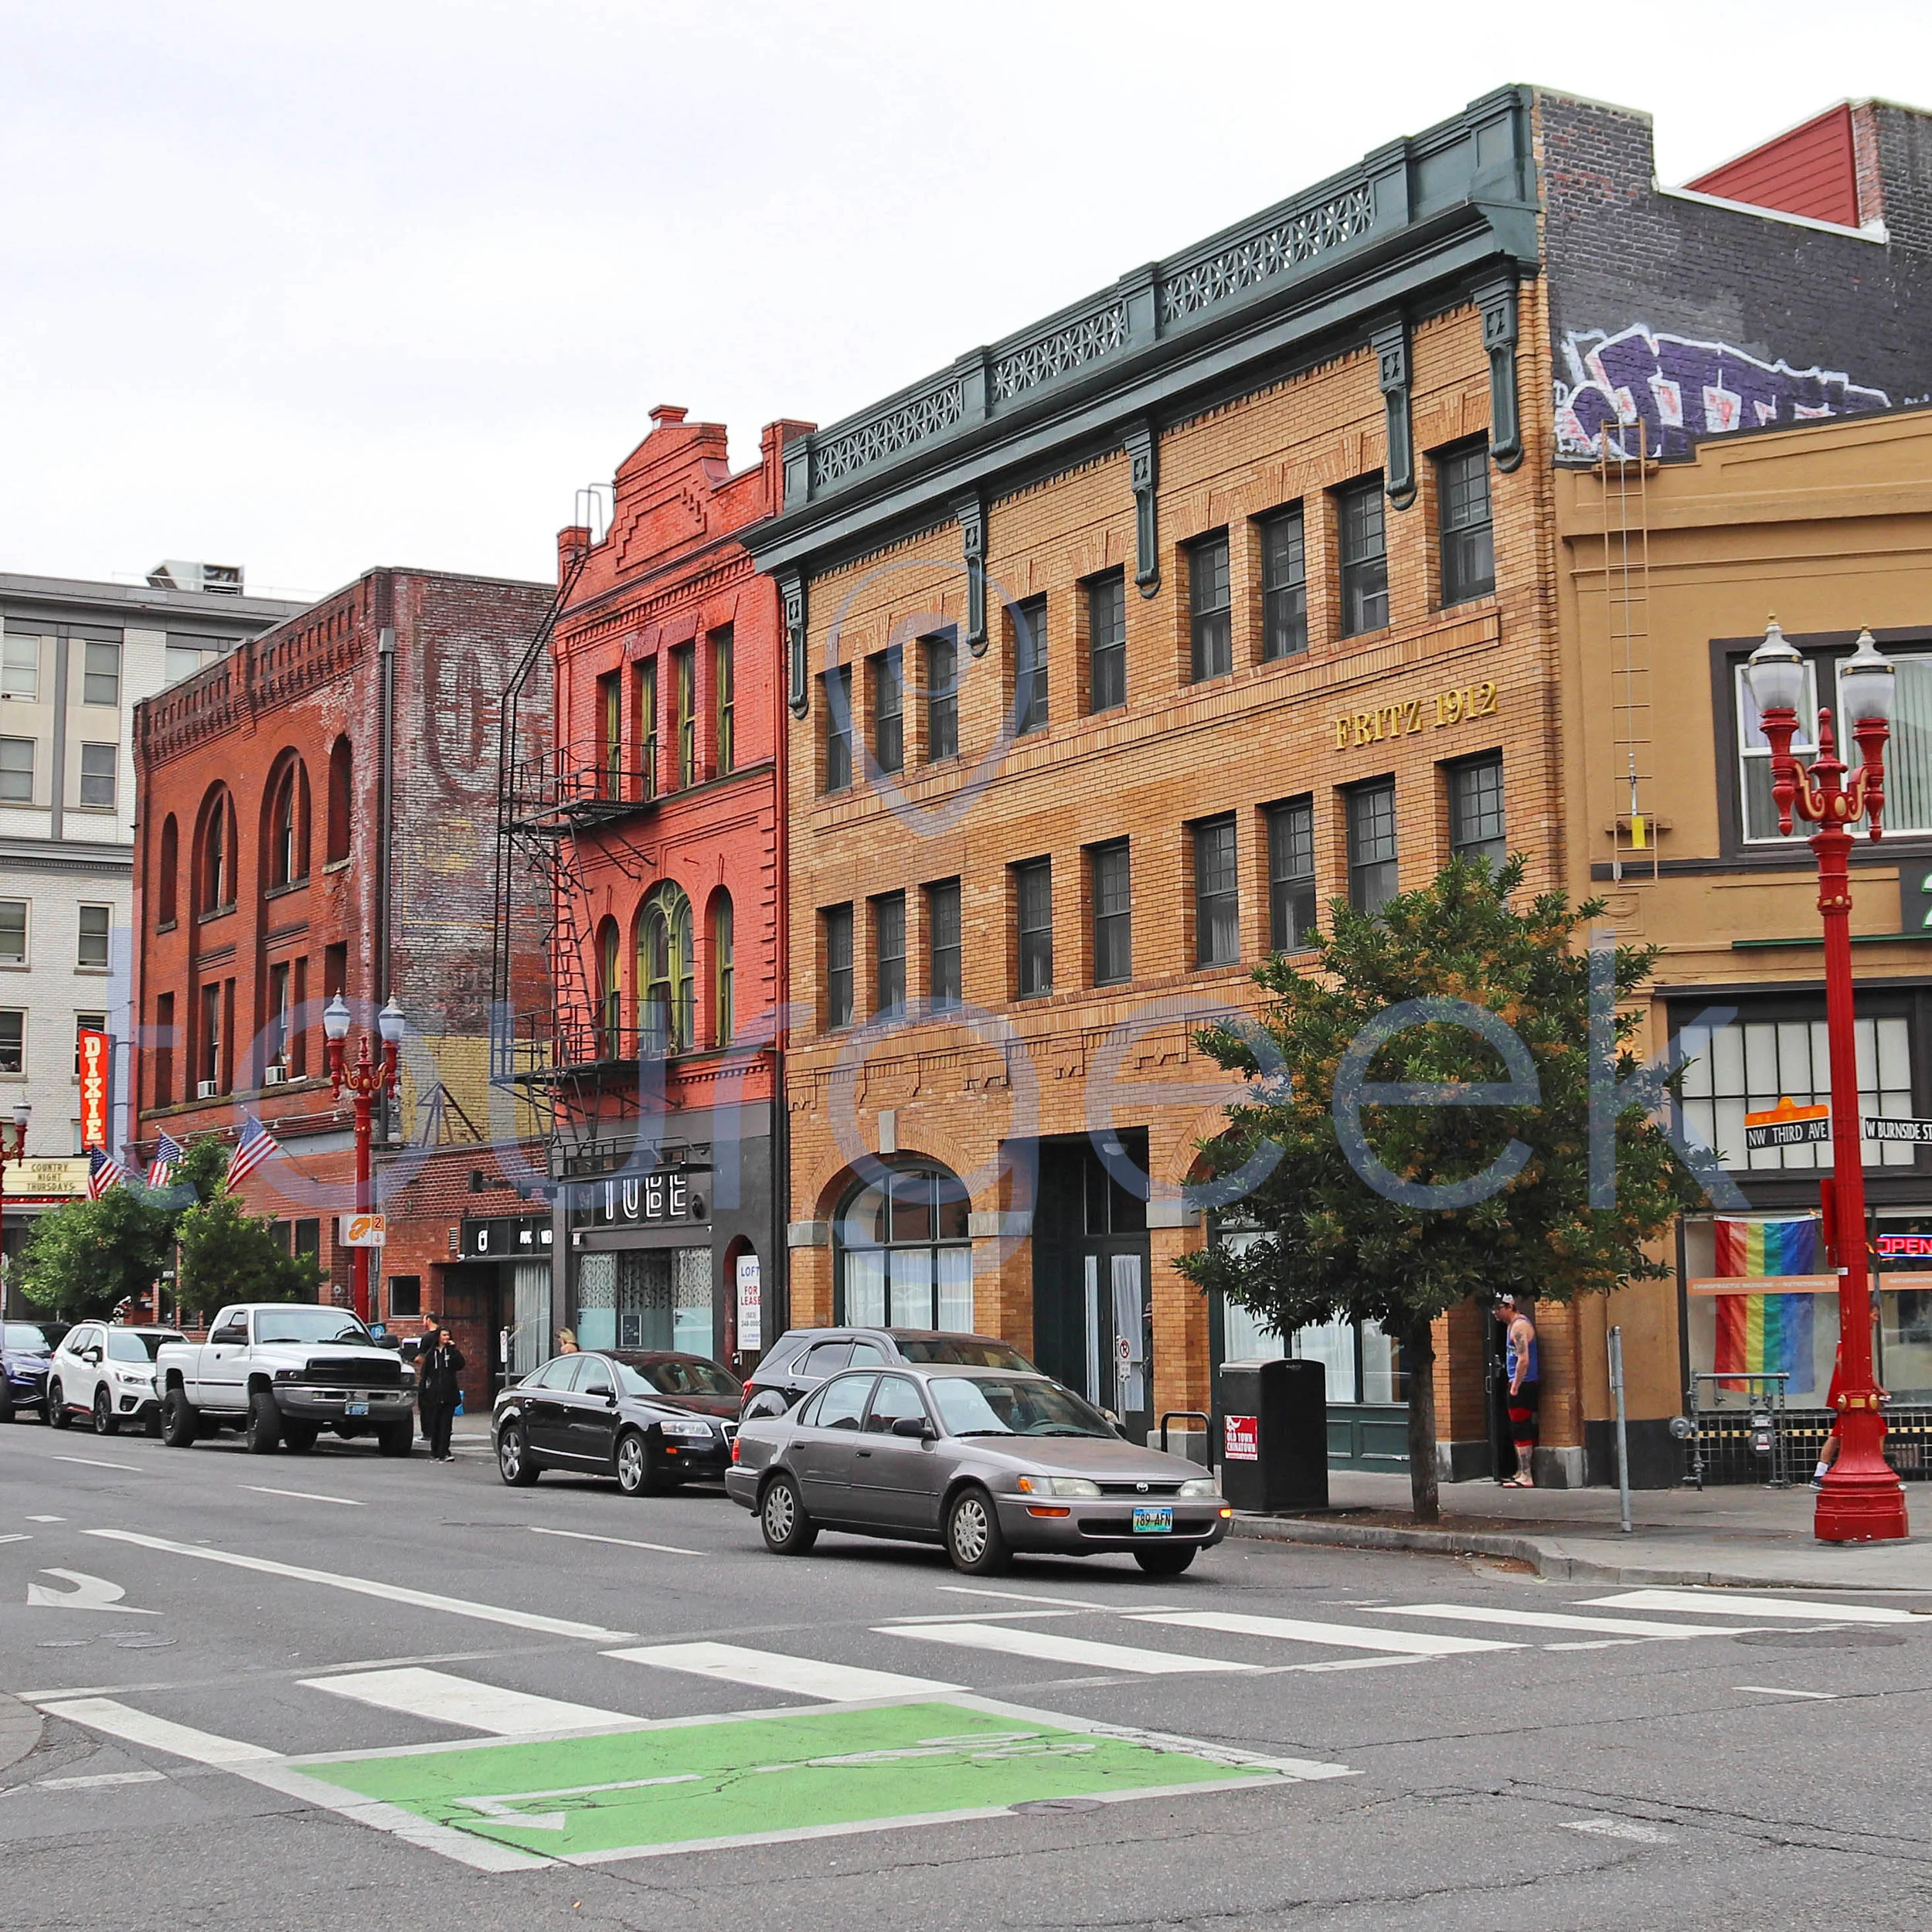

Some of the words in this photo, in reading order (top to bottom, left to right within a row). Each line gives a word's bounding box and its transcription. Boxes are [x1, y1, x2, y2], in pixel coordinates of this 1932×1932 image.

[1334, 699, 1422, 751] FRITZ
[1434, 681, 1498, 728] 1912
[83, 1036, 103, 1141] DIXIE
[1748, 1129, 1767, 1146] NW
[1772, 1124, 1803, 1144] THIRD
[1808, 1121, 1827, 1139] AVE
[1866, 1121, 1876, 1137] W
[1877, 1121, 1921, 1140] BURNSIDE
[31, 1163, 69, 1172] COUNTRY
[38, 1173, 61, 1182] NIGHT
[374, 1217, 382, 1229] 2
[744, 1285, 758, 1295] FOR
[740, 1296, 762, 1306] LEASE
[1226, 1432, 1237, 1442] OLD
[1237, 1432, 1253, 1443] TOWN
[1134, 1513, 1150, 1527] 789
[1155, 1512, 1171, 1527] AFN
